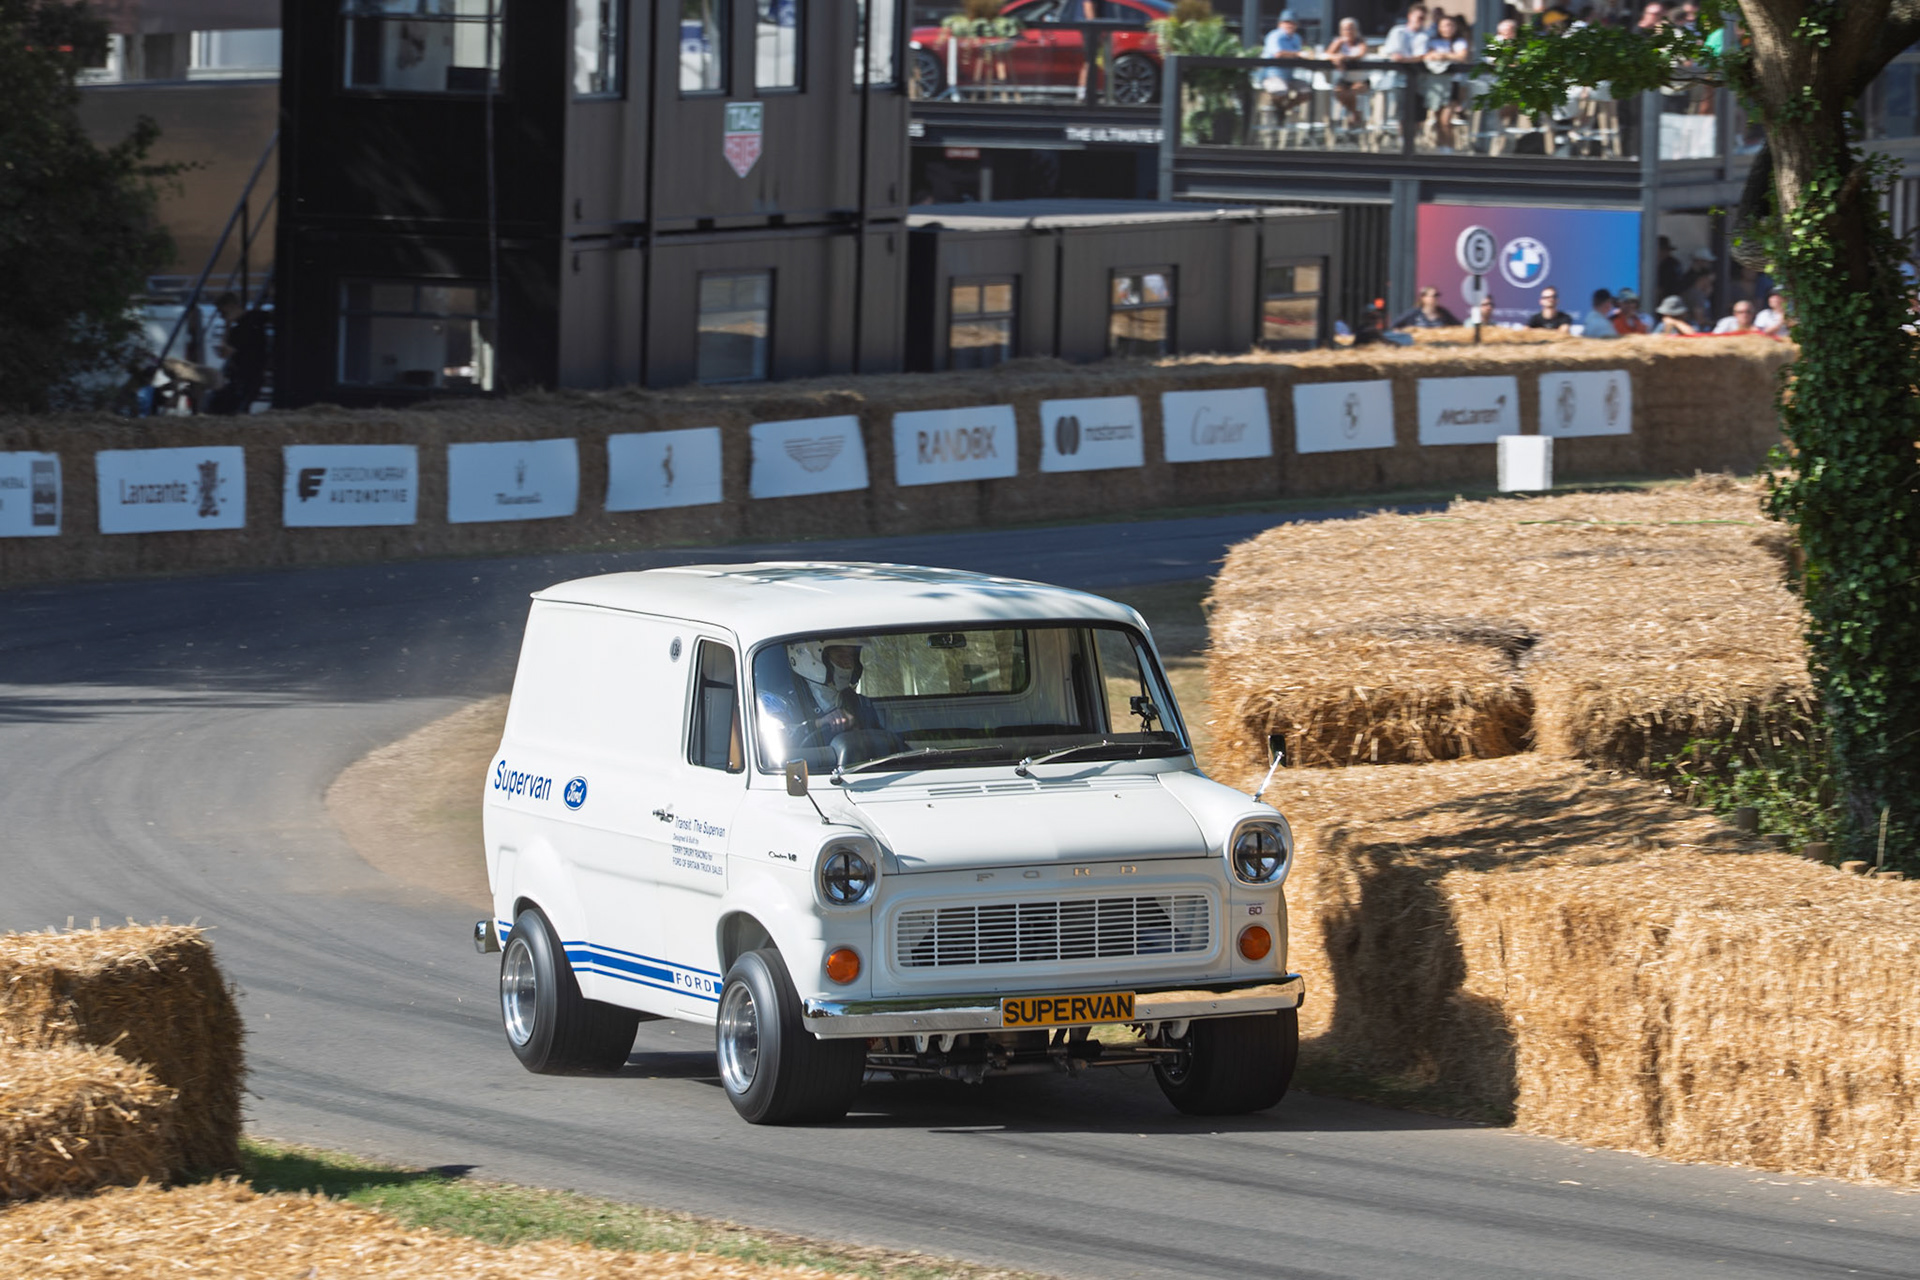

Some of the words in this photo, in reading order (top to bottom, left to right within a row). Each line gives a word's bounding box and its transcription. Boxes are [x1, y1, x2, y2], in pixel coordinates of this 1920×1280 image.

[727, 106, 762, 130] TAG
[1474, 239, 1485, 263] 6
[119, 479, 188, 505] Lanzante
[495, 759, 552, 801] Supervan
[566, 779, 586, 804] Ford
[694, 819, 703, 833] The
[703, 821, 725, 838] Supervan
[976, 865, 1137, 882] FORD
[1248, 906, 1262, 916] 60
[676, 972, 712, 992] FORD
[1004, 994, 1133, 1024] SUPERVAN
